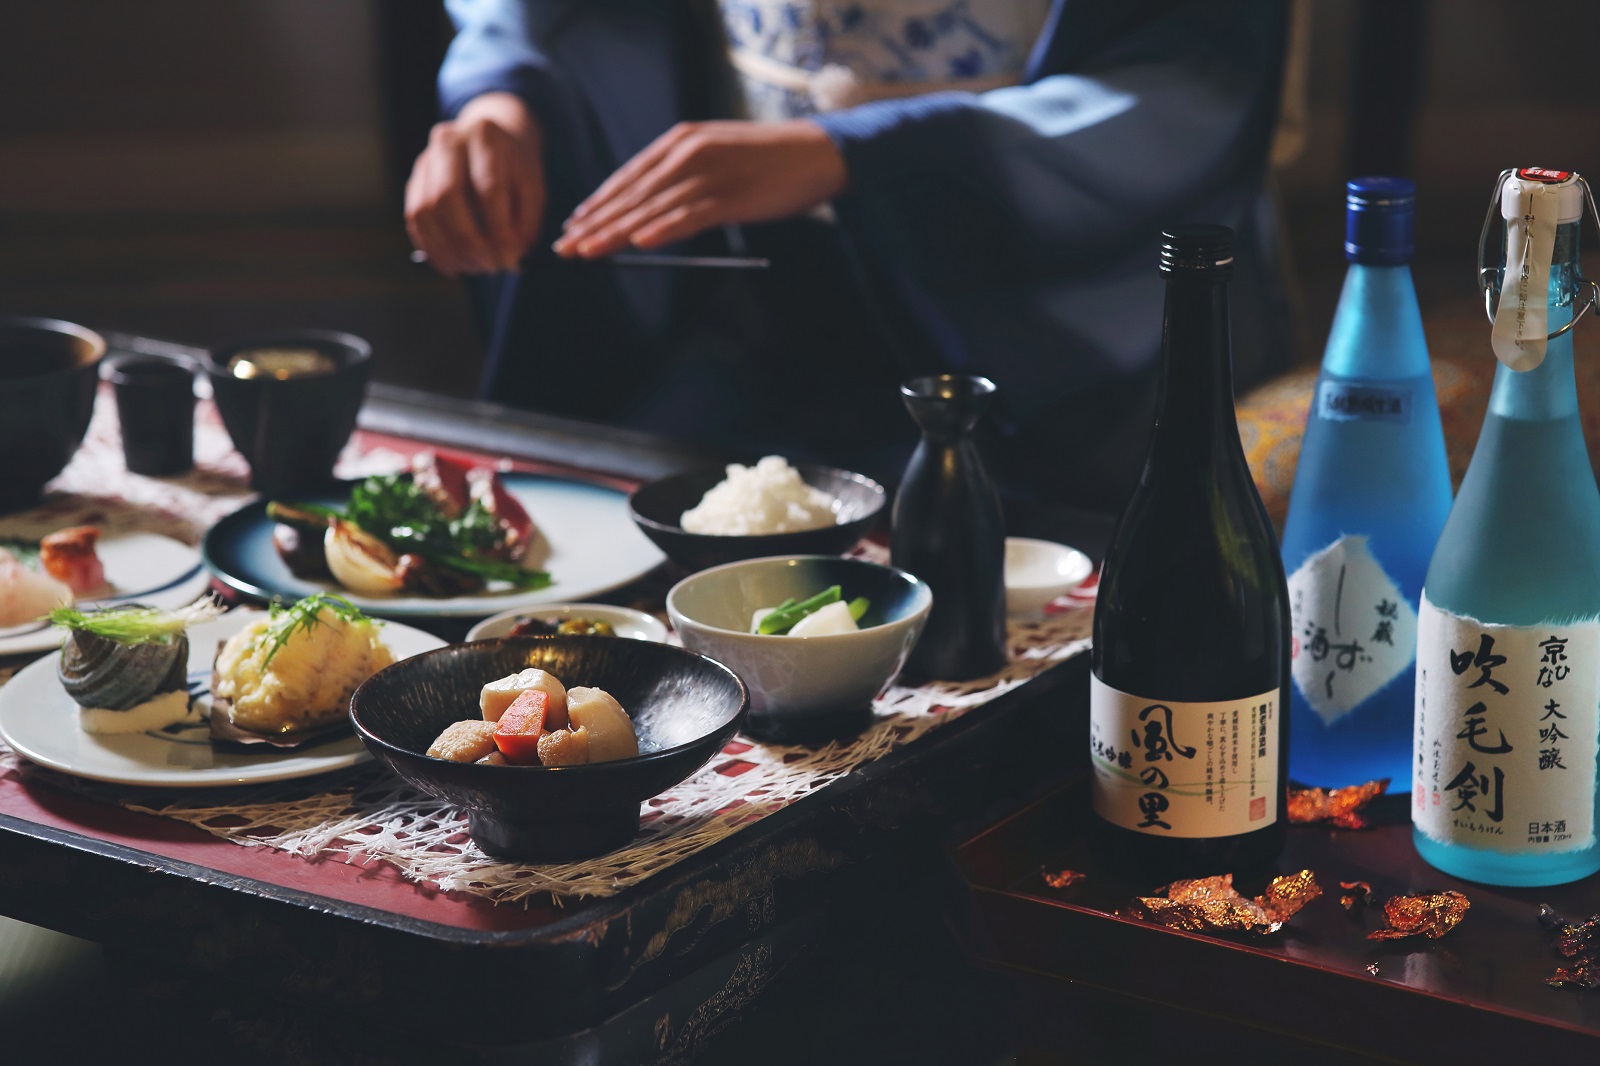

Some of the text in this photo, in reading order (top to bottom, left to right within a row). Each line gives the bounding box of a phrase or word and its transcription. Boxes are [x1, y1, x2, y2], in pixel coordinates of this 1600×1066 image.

[1444, 633, 1513, 822] 吹毛剣
[1539, 698, 1570, 770] 大吟醸
[1131, 704, 1197, 830] 風の里
[1528, 820, 1567, 834] 日本酒
[1528, 835, 1550, 843] 内容量
